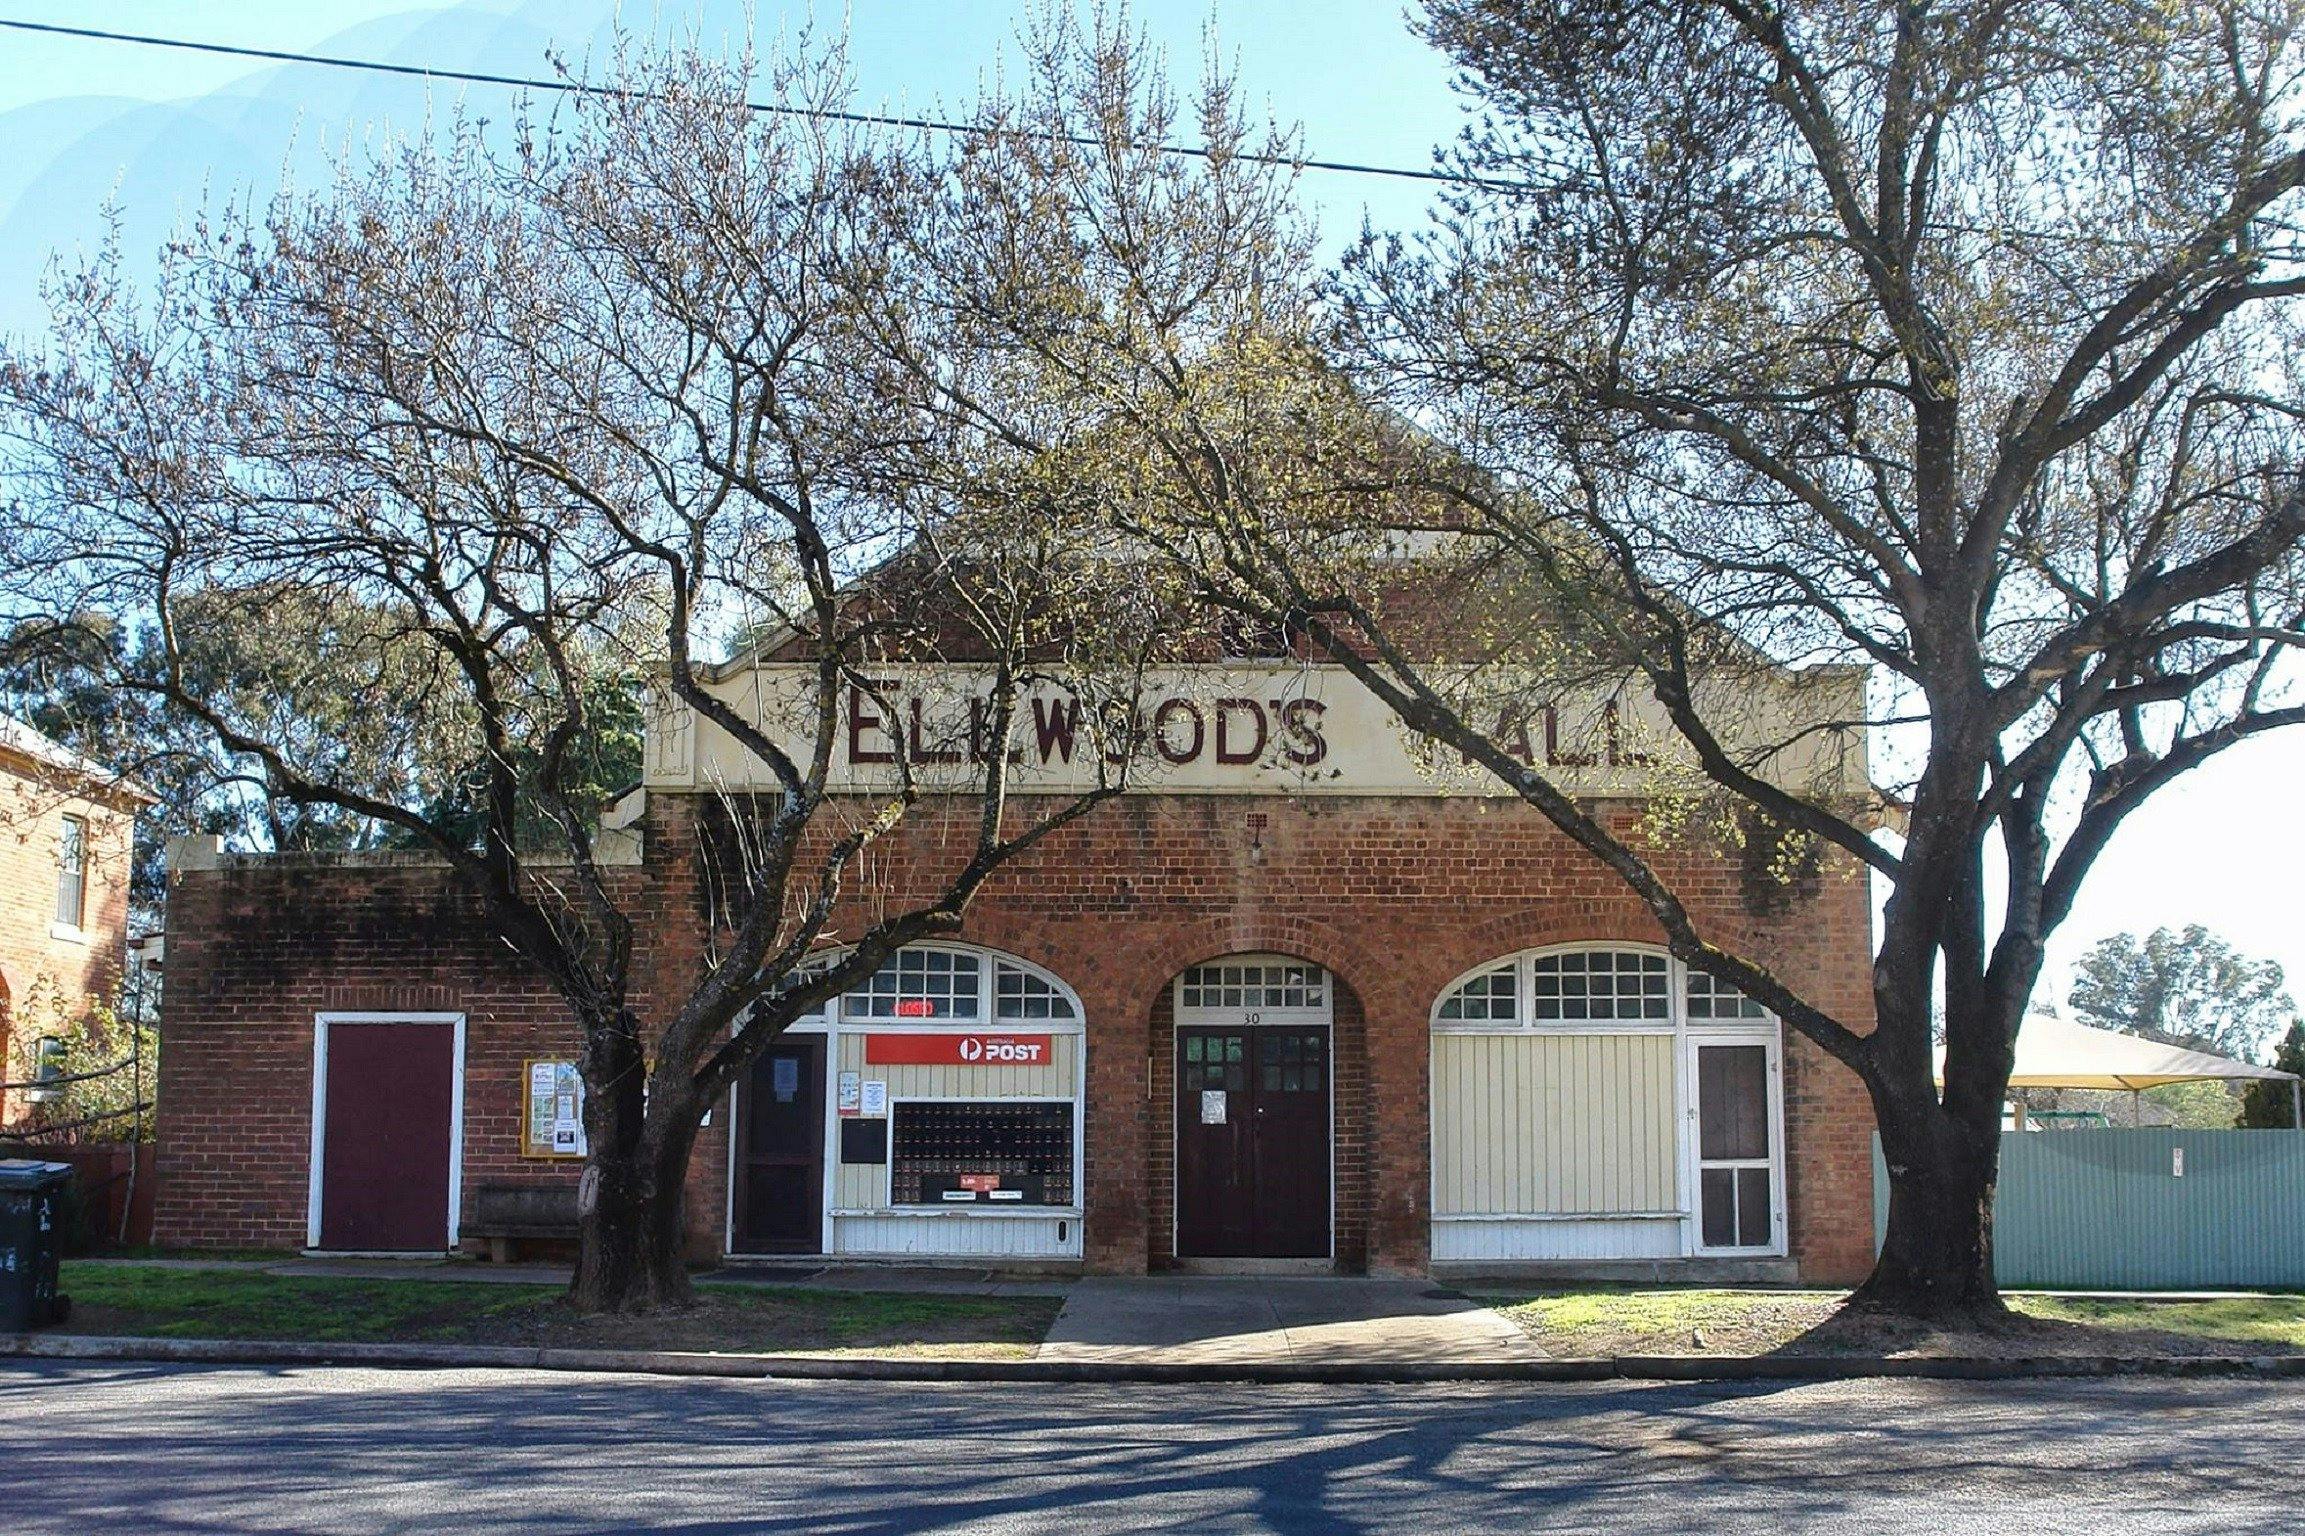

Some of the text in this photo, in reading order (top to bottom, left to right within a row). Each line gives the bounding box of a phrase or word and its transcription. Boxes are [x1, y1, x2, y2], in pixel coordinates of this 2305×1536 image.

[849, 680, 1328, 767] ELLWOOD'S
[1244, 1012, 1260, 1024] 30
[985, 1044, 1042, 1061] POST
